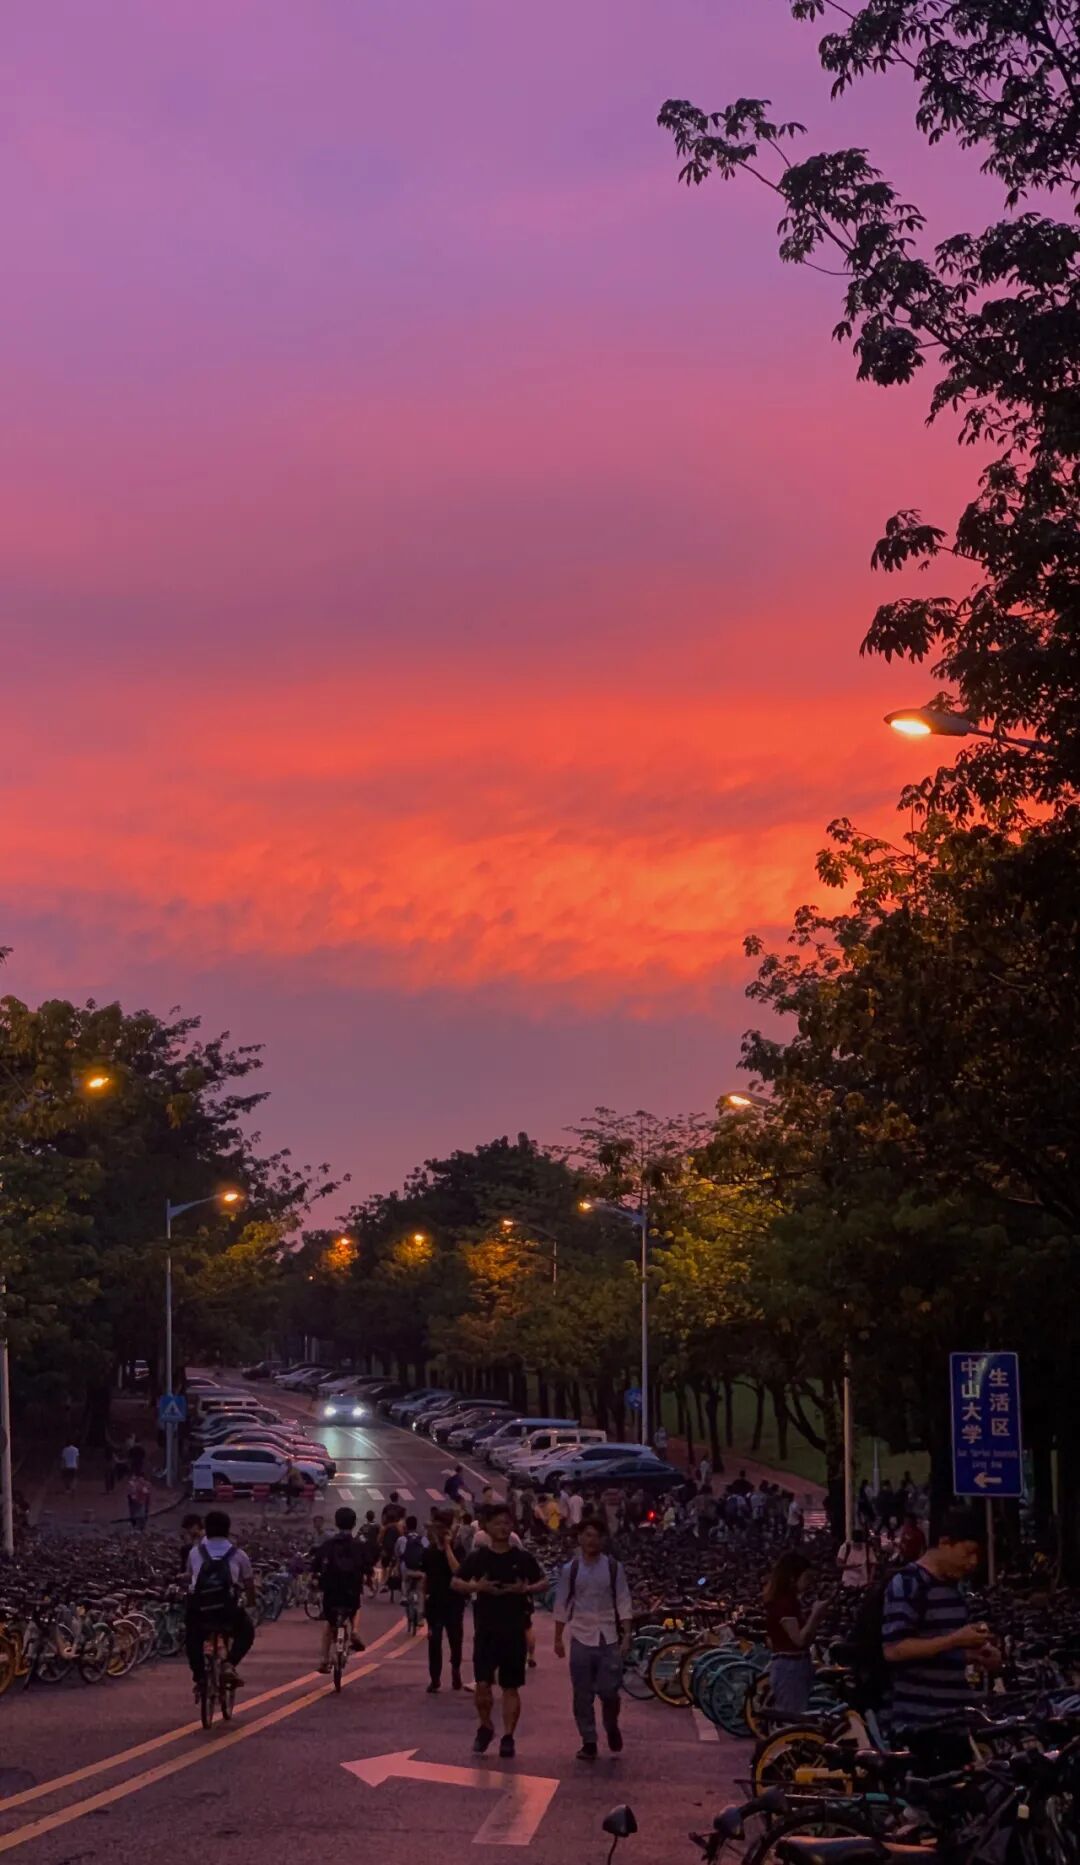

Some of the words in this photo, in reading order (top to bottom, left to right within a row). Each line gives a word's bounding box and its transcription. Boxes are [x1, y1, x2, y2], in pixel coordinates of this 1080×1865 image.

[961, 1358, 982, 1444] 中山大学
[989, 1367, 1010, 1437] 生活区
